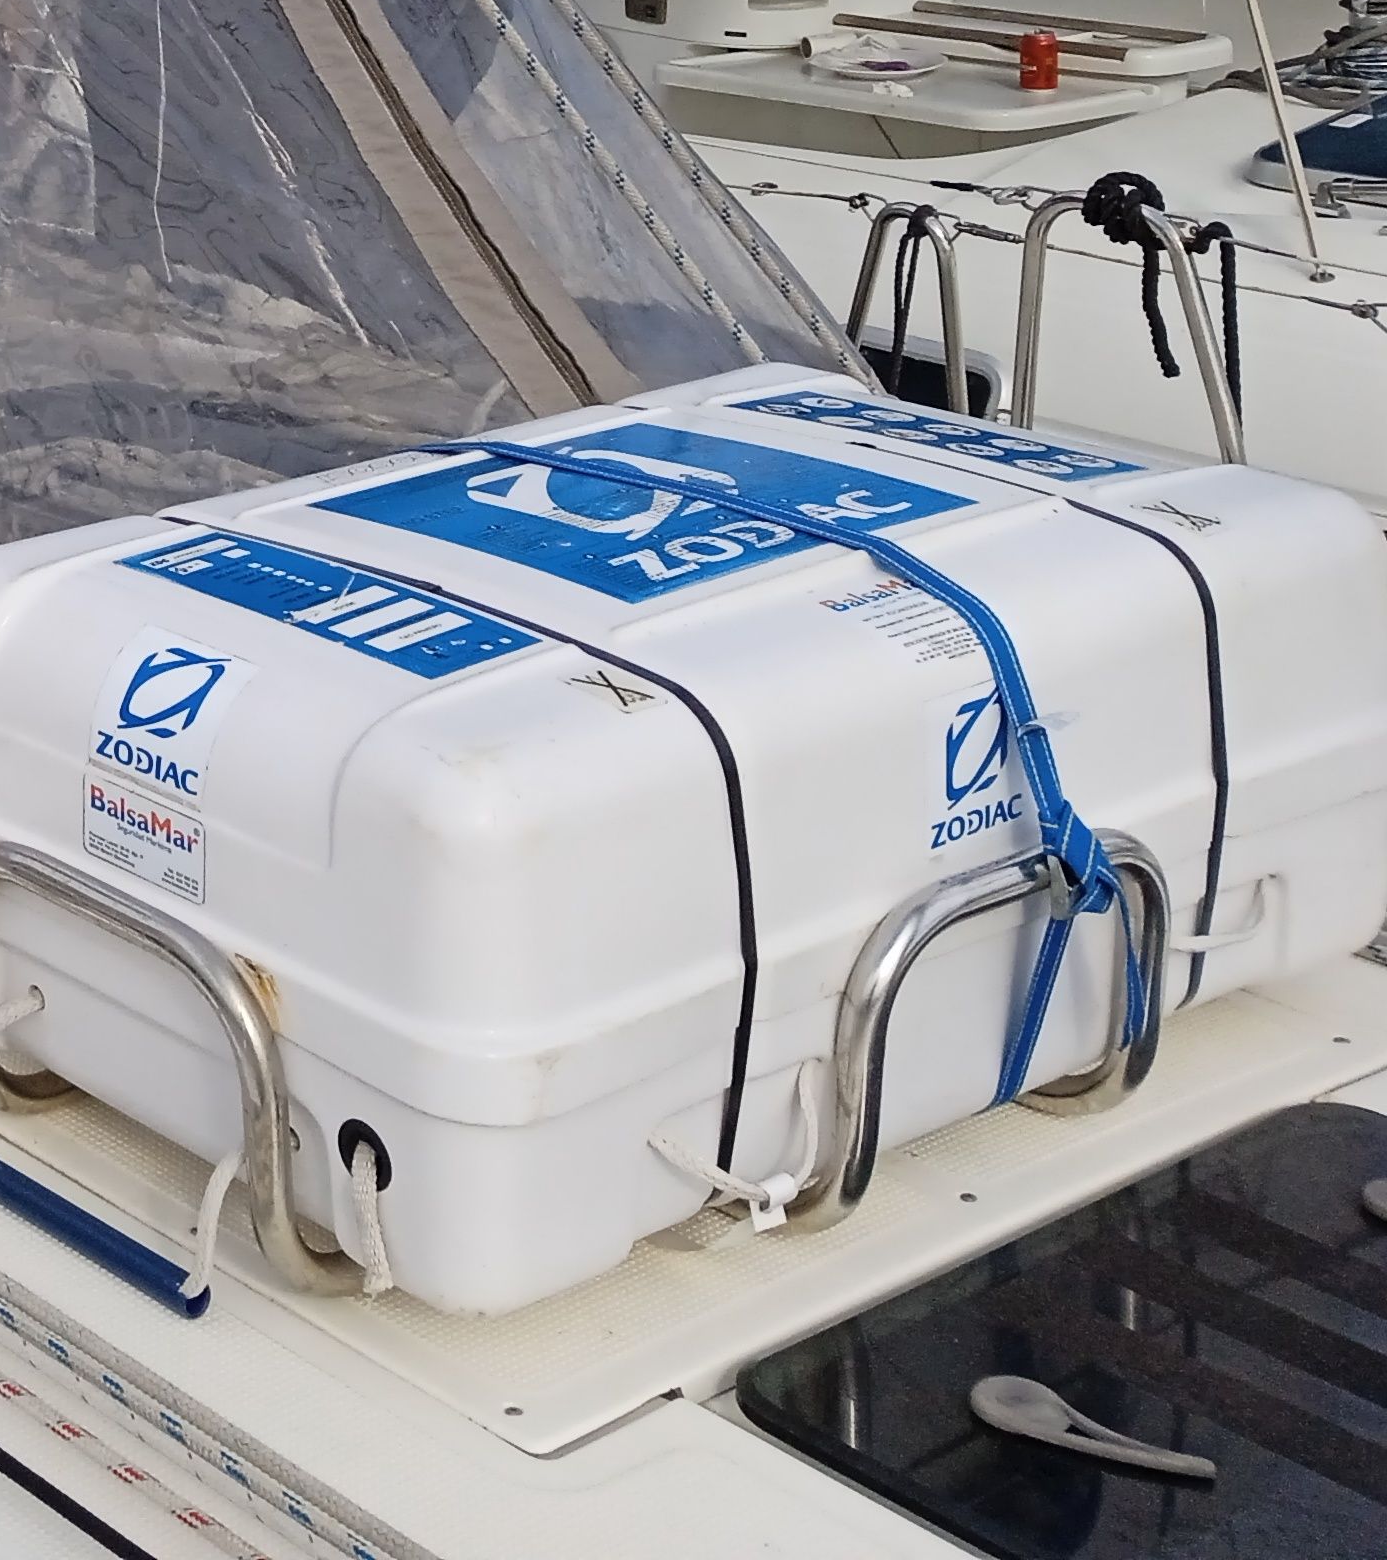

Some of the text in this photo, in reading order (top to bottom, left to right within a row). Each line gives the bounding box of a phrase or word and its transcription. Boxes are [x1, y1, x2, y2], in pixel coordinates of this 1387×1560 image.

[607, 490, 913, 582] ZODAC
[95, 730, 199, 796] ZODIAC
[90, 783, 199, 853] BalsaMar
[930, 793, 1023, 850] ZODIAC
